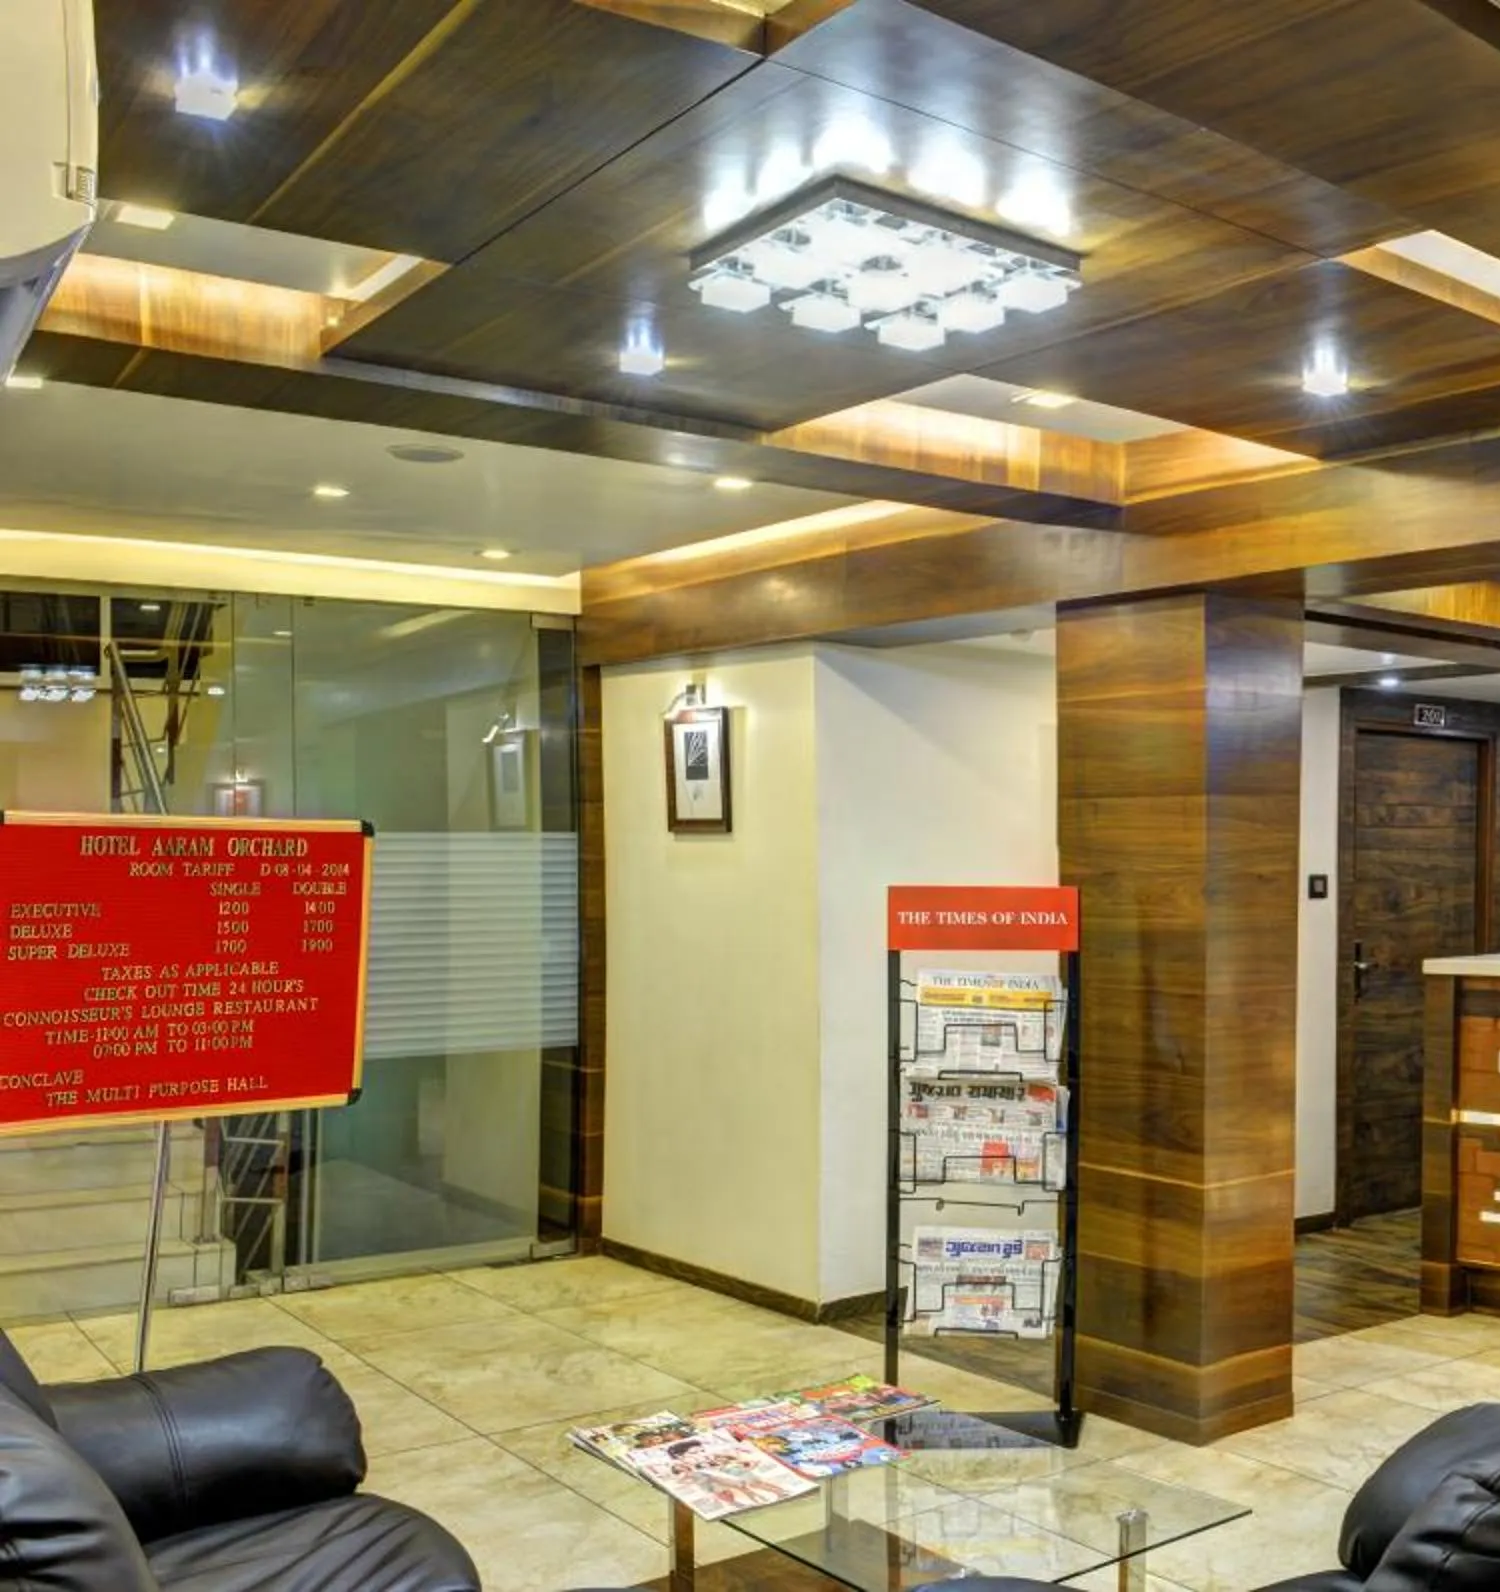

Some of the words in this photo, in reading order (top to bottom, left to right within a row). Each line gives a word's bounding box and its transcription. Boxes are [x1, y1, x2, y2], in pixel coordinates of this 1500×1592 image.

[80, 836, 140, 856] HOTEL
[151, 838, 214, 857] AARAM
[227, 838, 308, 857] ORCHARD
[129, 863, 173, 876] ROOM
[183, 863, 235, 877] TARIFF
[210, 882, 261, 896] SINGLE
[293, 882, 347, 895] DOUBLE
[10, 903, 101, 919] EXECUTIVE
[218, 901, 249, 915] 1200
[305, 901, 335, 914] 1400
[898, 911, 930, 925] THE
[936, 911, 988, 925] TIMES
[992, 911, 1015, 925] OF
[1020, 912, 1068, 925] INDIA
[10, 925, 73, 940] DELUXE
[217, 921, 249, 934] 1500
[303, 920, 333, 933] 1700
[7, 945, 57, 961] SUPER
[67, 943, 131, 959] DELUXE
[215, 940, 247, 954] 1700
[302, 940, 333, 952] 1900
[102, 966, 152, 981] TAXES
[160, 964, 179, 978] AS
[185, 961, 279, 977] APPLICABLE
[84, 985, 137, 1001] CHECK
[145, 984, 178, 999] OUT
[183, 982, 221, 997] TIME
[229, 981, 247, 995] 24
[141, 1001, 204, 1019] LOUNGE
[213, 997, 319, 1015] RESTAURANT
[133, 1024, 159, 1039] AM
[167, 1023, 188, 1037] TO
[231, 1019, 254, 1033] PM
[135, 1041, 158, 1055] PM
[167, 1039, 187, 1053] TO
[231, 1035, 253, 1049] PM
[0, 1069, 84, 1089] CONCLAVE
[47, 1091, 79, 1107] THE
[87, 1086, 140, 1103] MULTI
[149, 1079, 220, 1098] PURPOSE
[227, 1075, 269, 1091] HALL
